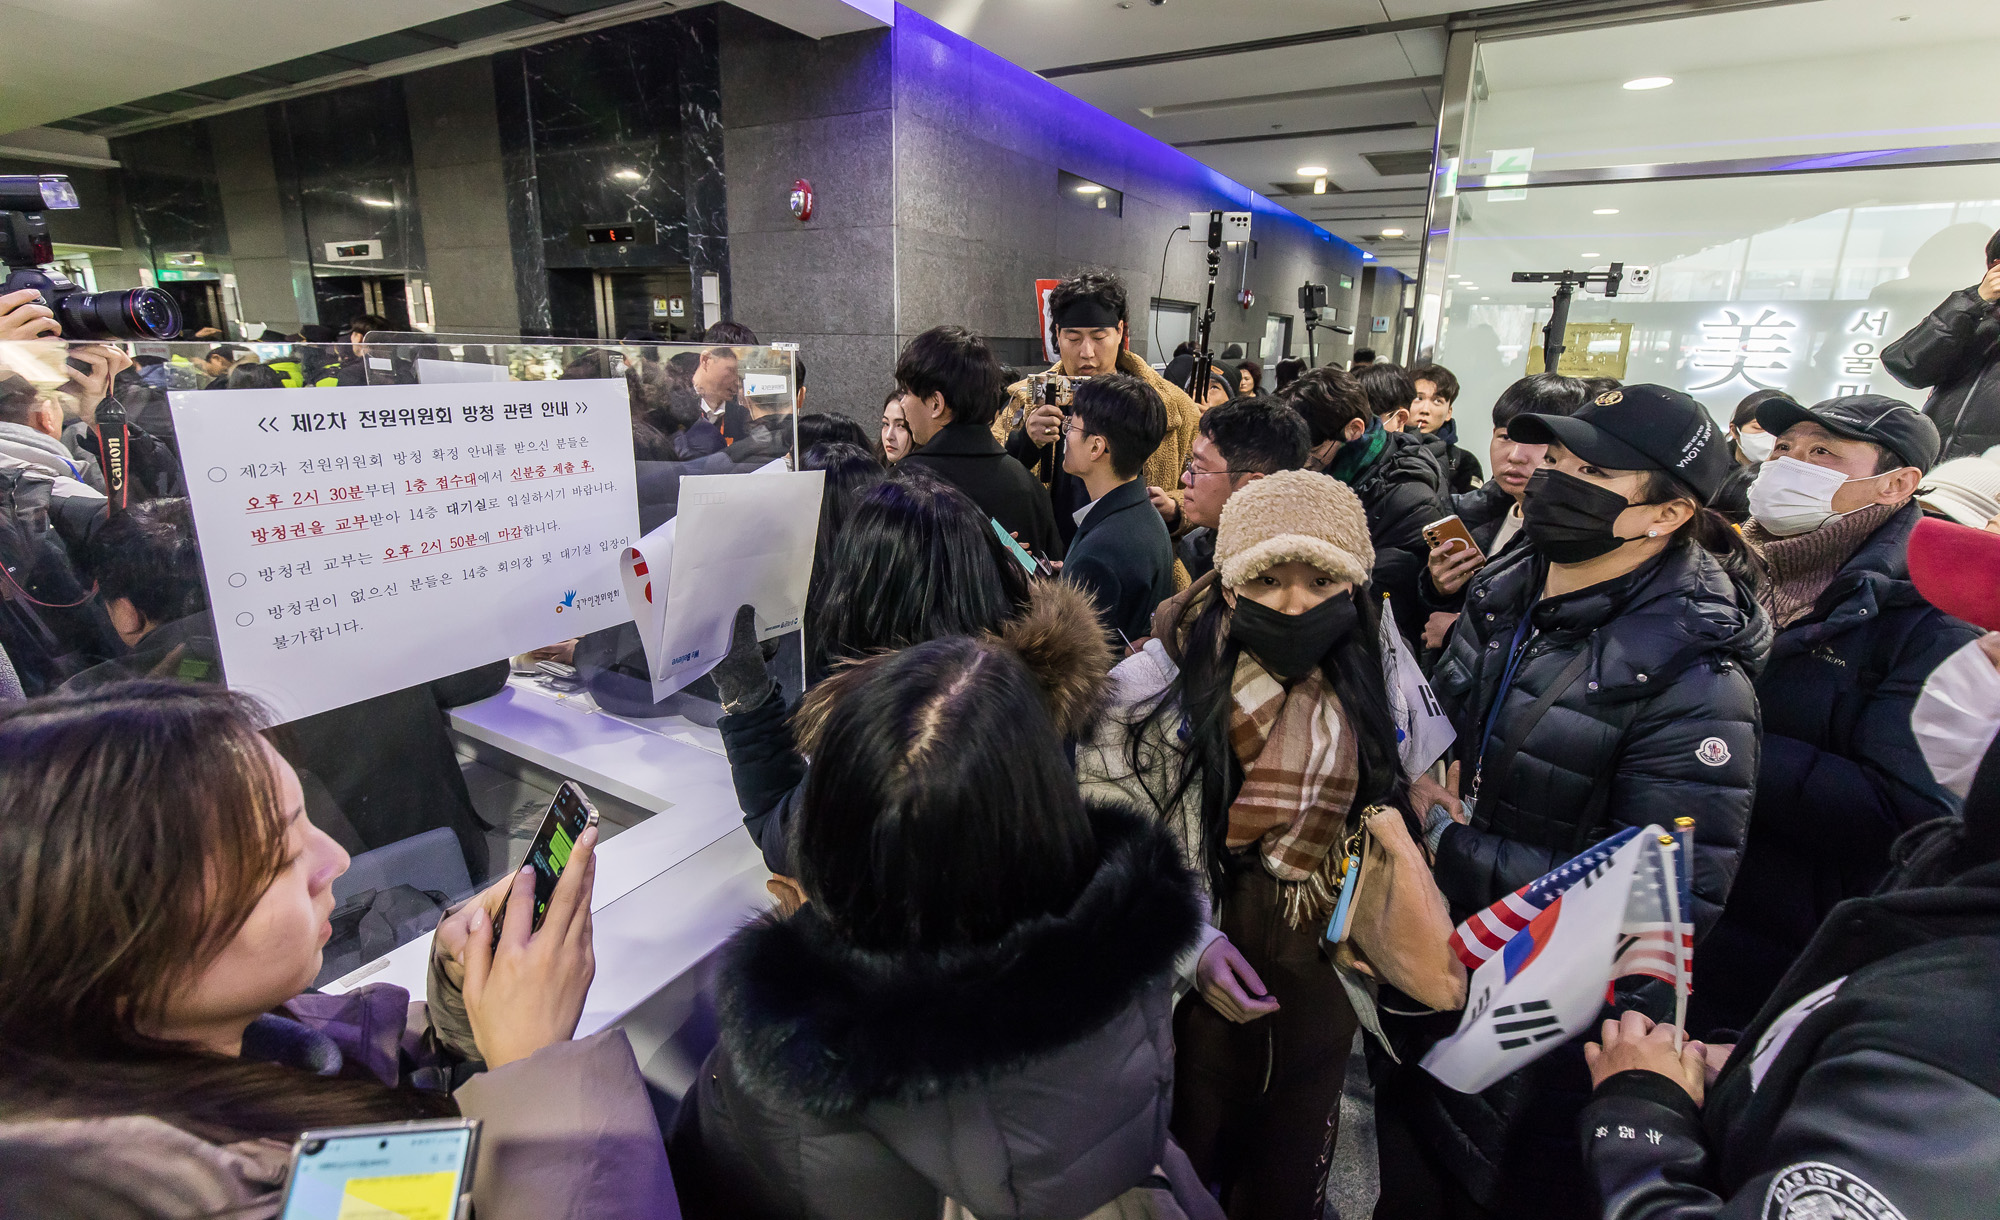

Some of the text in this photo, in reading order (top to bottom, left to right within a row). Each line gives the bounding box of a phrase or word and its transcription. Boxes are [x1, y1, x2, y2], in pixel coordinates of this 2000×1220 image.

[1687, 309, 1797, 390] 美
[291, 411, 347, 432] 제2차
[358, 406, 453, 429] 전원위원회
[463, 404, 494, 423] 방청
[503, 402, 533, 420] 관련
[541, 401, 569, 418] 안내
[108, 438, 123, 491] Canon
[240, 436, 590, 479] 제2차 전원위원회 방청 확정 안내를 받으신 분들은
[1676, 447, 1700, 468] LONA
[246, 493, 284, 511] 오후
[293, 489, 319, 505] 2시
[330, 482, 396, 501] 30분부터
[405, 478, 428, 493] 1층
[435, 470, 503, 489] 접수대에서
[510, 465, 547, 481] 신분증
[553, 461, 575, 475] 제출
[251, 481, 617, 543] 방청권을 교부받아 14층 대기실로 입실하시기 바랍니다.
[258, 519, 561, 582] 방청권 교부는 오후 2시 50분에 마감합니다.
[268, 536, 629, 620] 방청권이 없으신 분들은 14층 회의장 및 대기실 입장이
[575, 589, 620, 611] 국가인권위원회
[272, 619, 364, 650] 불가합니다.
[1774, 1171, 1806, 1205] DAS
[1806, 1168, 1842, 1190] IST
